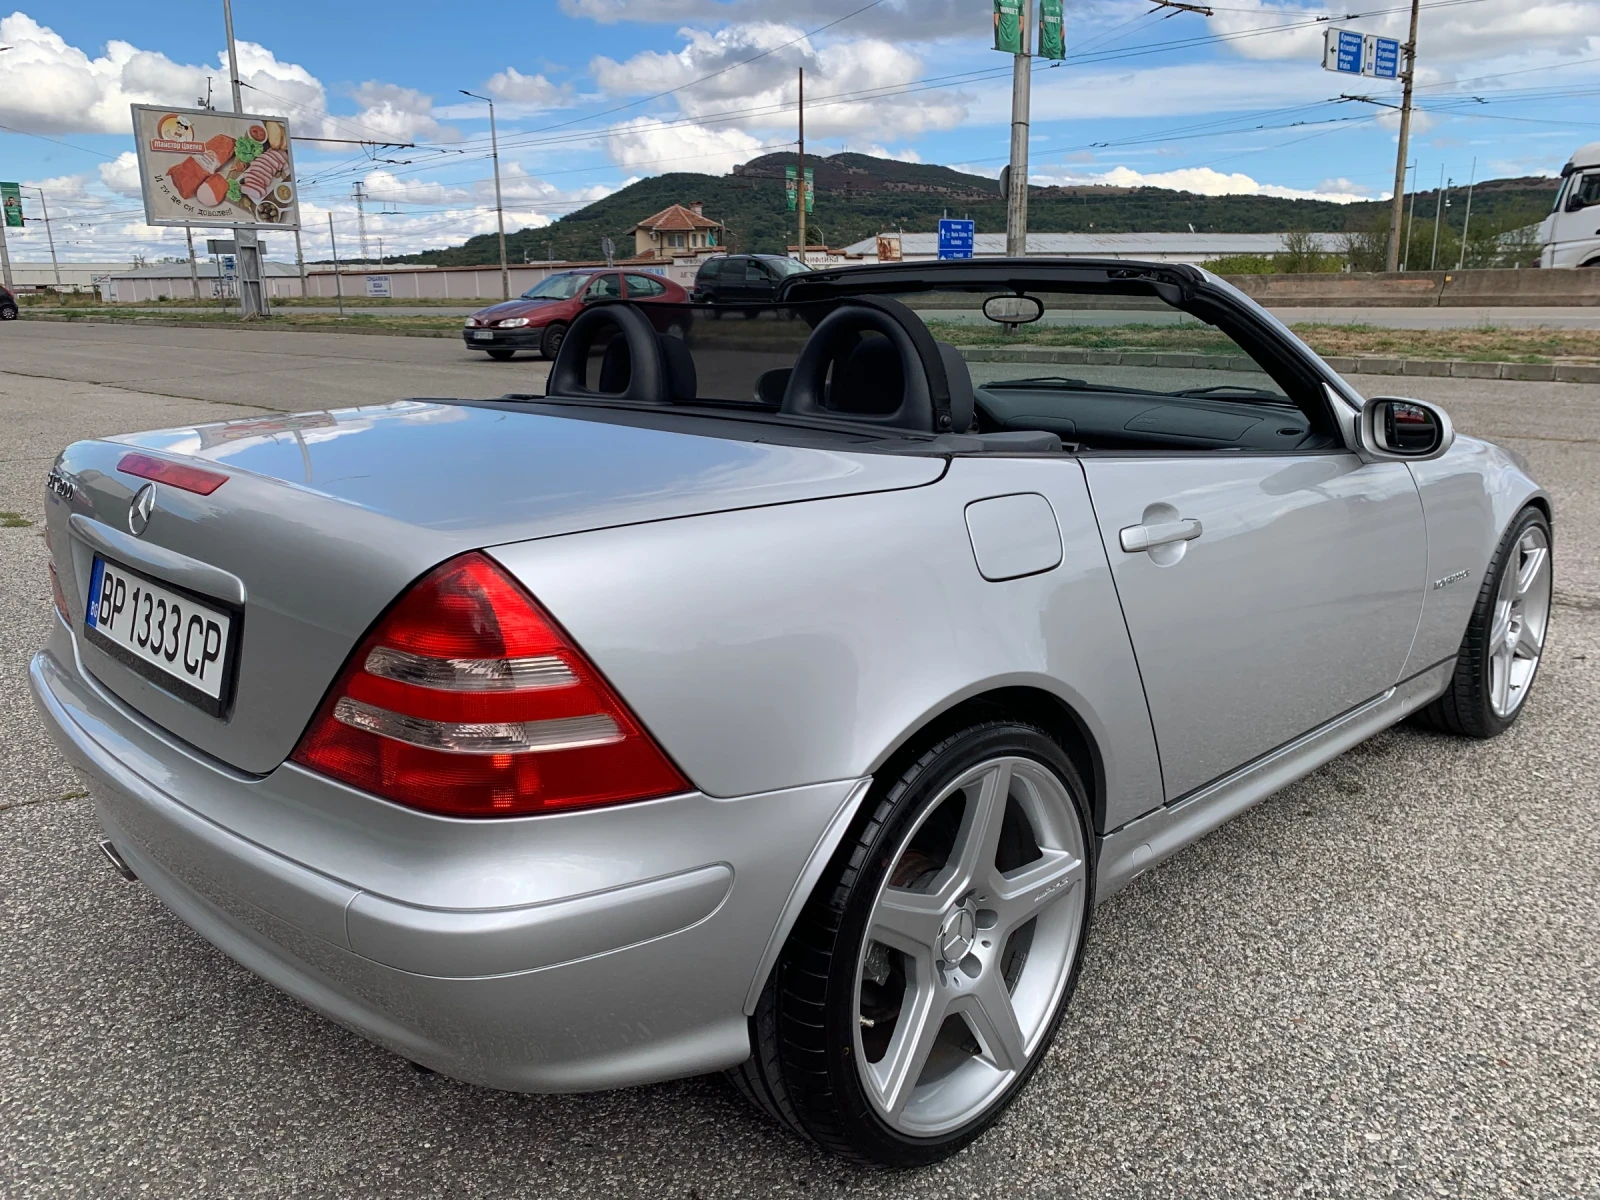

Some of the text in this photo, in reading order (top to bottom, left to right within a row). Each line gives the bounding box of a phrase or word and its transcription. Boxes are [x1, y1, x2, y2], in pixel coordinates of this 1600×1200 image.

[154, 140, 181, 150] Майстор
[154, 174, 164, 183] И
[160, 185, 170, 196] ти
[183, 205, 194, 213] си
[90, 600, 98, 618] BG
[99, 571, 222, 681] BP 1333 CP
